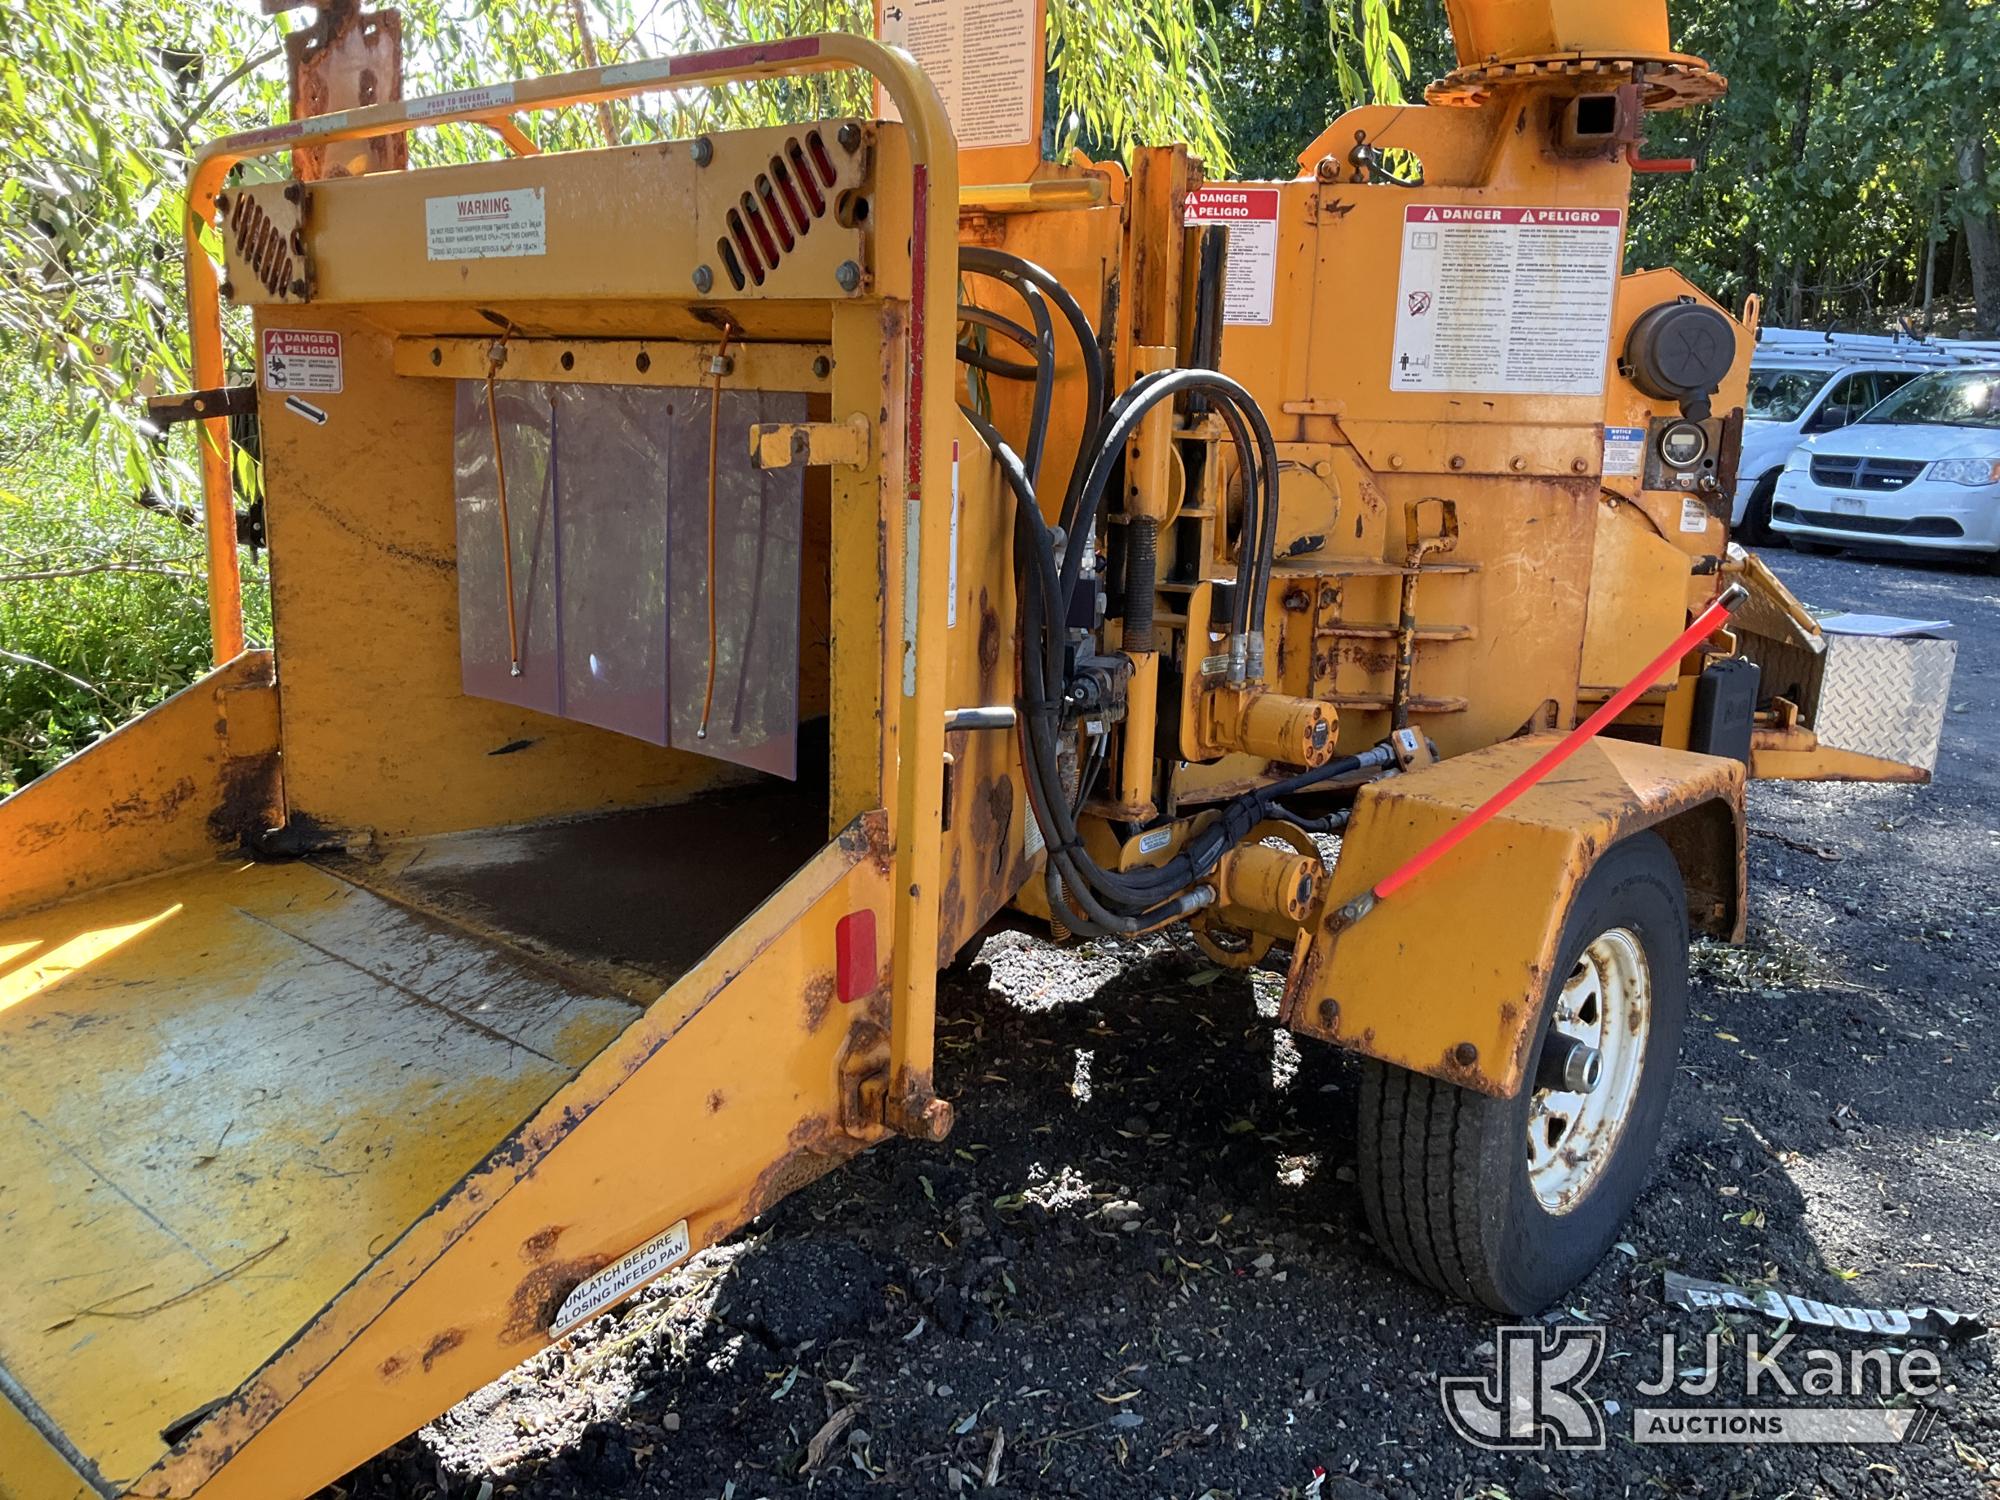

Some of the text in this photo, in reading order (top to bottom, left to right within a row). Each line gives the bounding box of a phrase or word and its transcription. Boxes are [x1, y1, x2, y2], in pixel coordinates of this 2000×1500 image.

[1200, 193, 1247, 204] DANGER
[457, 198, 510, 216] WARNING
[1199, 207, 1249, 217] PELIGRO
[1442, 209, 1502, 220] DANGER
[1538, 211, 1600, 222] PELIGRO
[284, 333, 334, 344] DANGER
[284, 345, 336, 354] PELIGRO
[564, 1233, 673, 1309] UNLATCH BEFORE
[555, 1241, 683, 1329] CLOSING INFEED PAN
